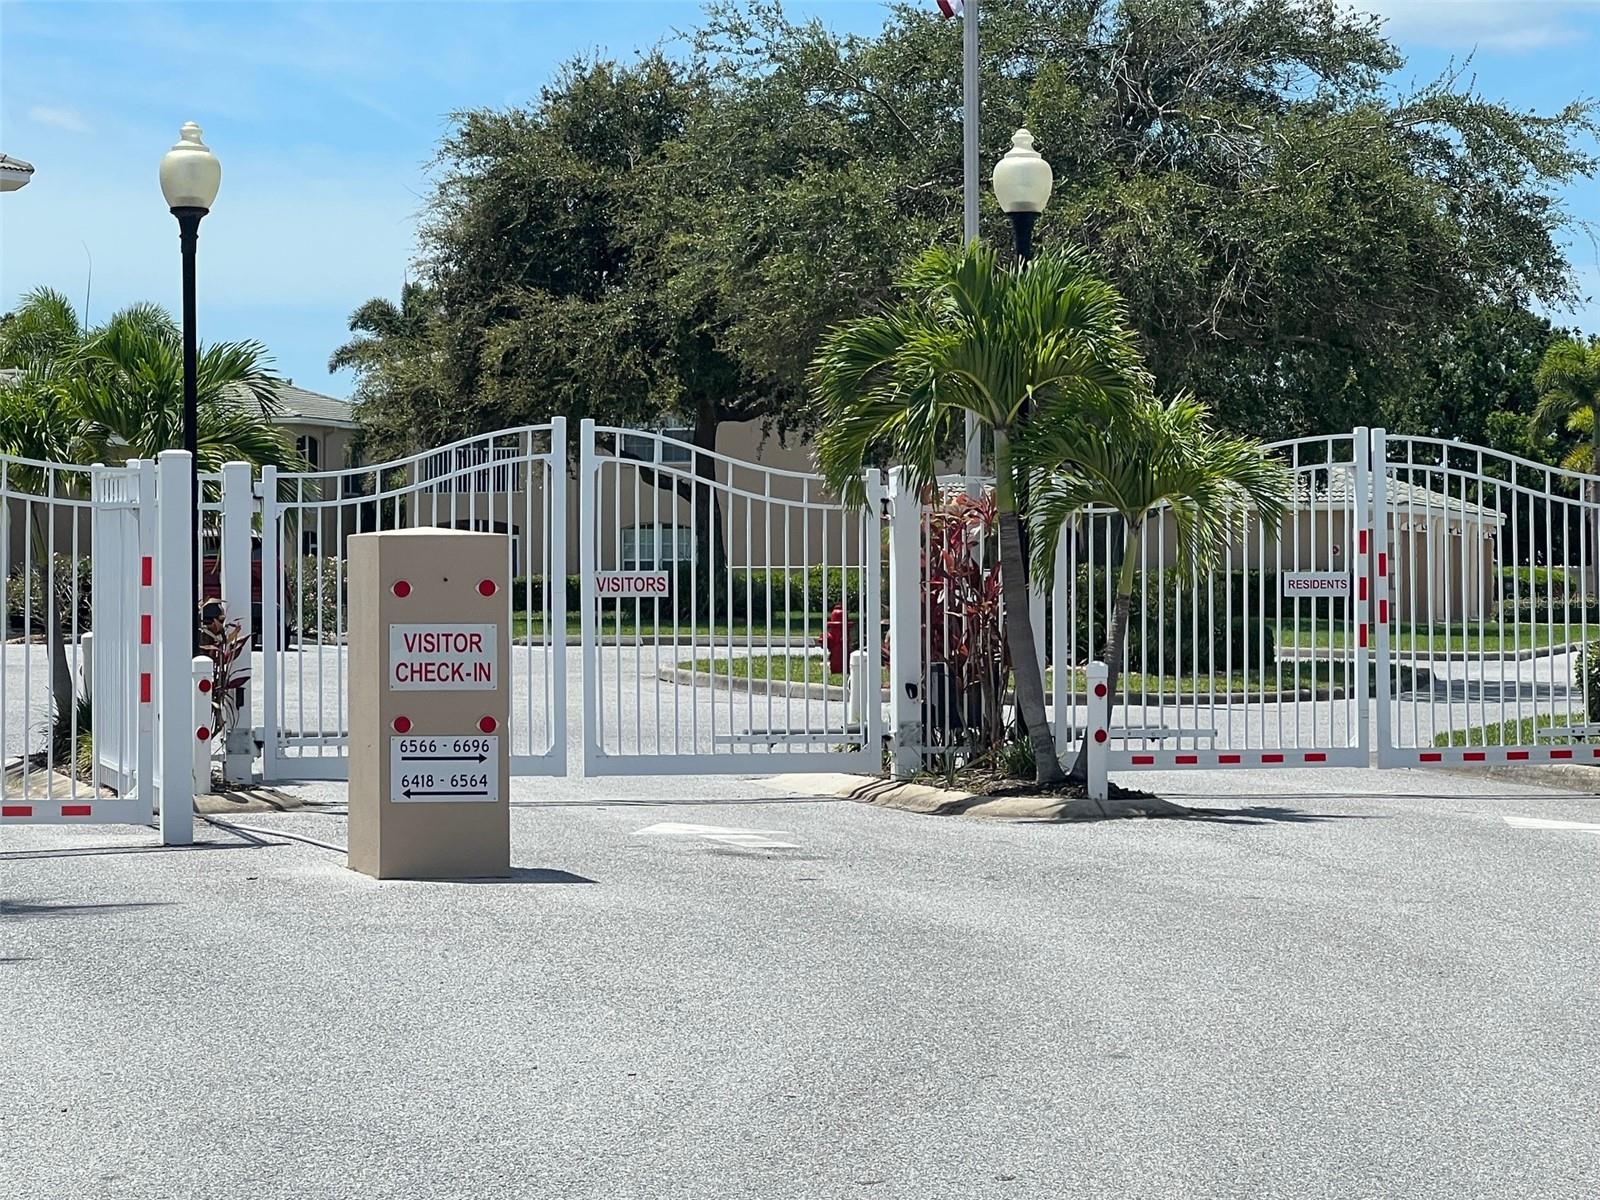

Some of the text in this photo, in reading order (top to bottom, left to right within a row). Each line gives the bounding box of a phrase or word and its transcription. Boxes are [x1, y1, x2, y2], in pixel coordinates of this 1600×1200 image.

[596, 577, 666, 592] VISITORS
[1288, 579, 1348, 589] RESIDENTS
[404, 633, 482, 653] VISITOR
[395, 662, 491, 682] CHECK-IN
[400, 739, 437, 753] 6566
[453, 739, 490, 753] 6696
[401, 774, 434, 788] 6418
[450, 774, 488, 787] 6564
